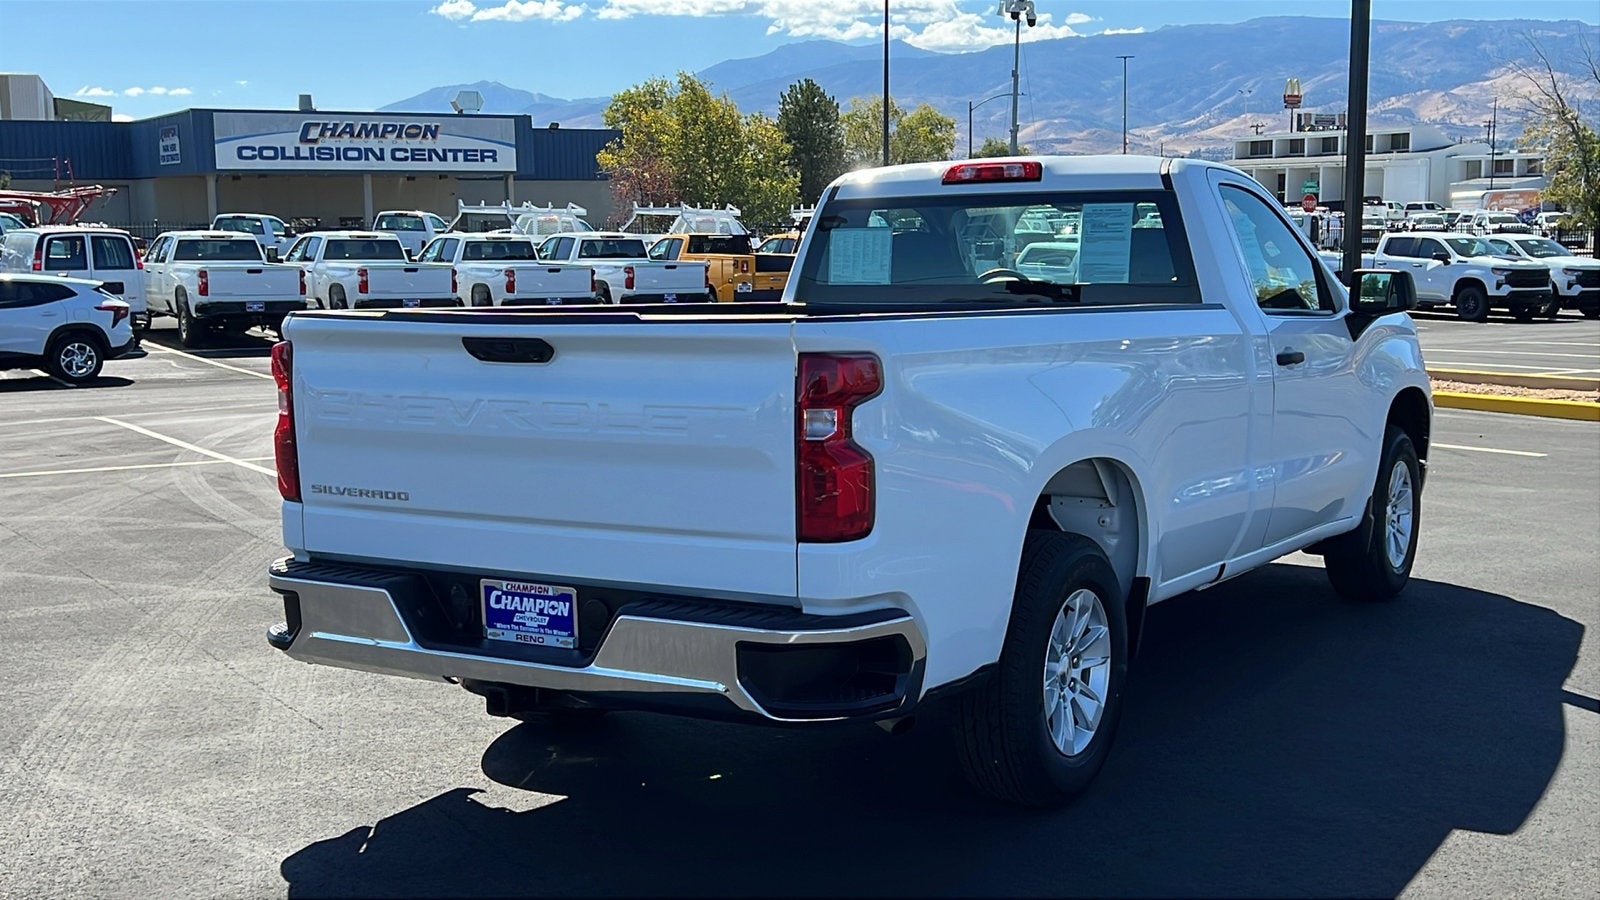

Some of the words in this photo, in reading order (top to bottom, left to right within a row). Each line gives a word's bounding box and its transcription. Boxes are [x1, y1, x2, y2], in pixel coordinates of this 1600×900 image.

[299, 120, 441, 144] CHAMPION
[236, 145, 385, 162] COLLISION
[390, 147, 498, 163] CENTER
[1302, 199, 1317, 208] STOP
[311, 484, 410, 501] SILVERADO
[506, 582, 549, 594] CHAMPION
[490, 590, 570, 617] CHAMPION
[515, 614, 547, 624] CHEVROLET
[515, 634, 545, 644] RENO
